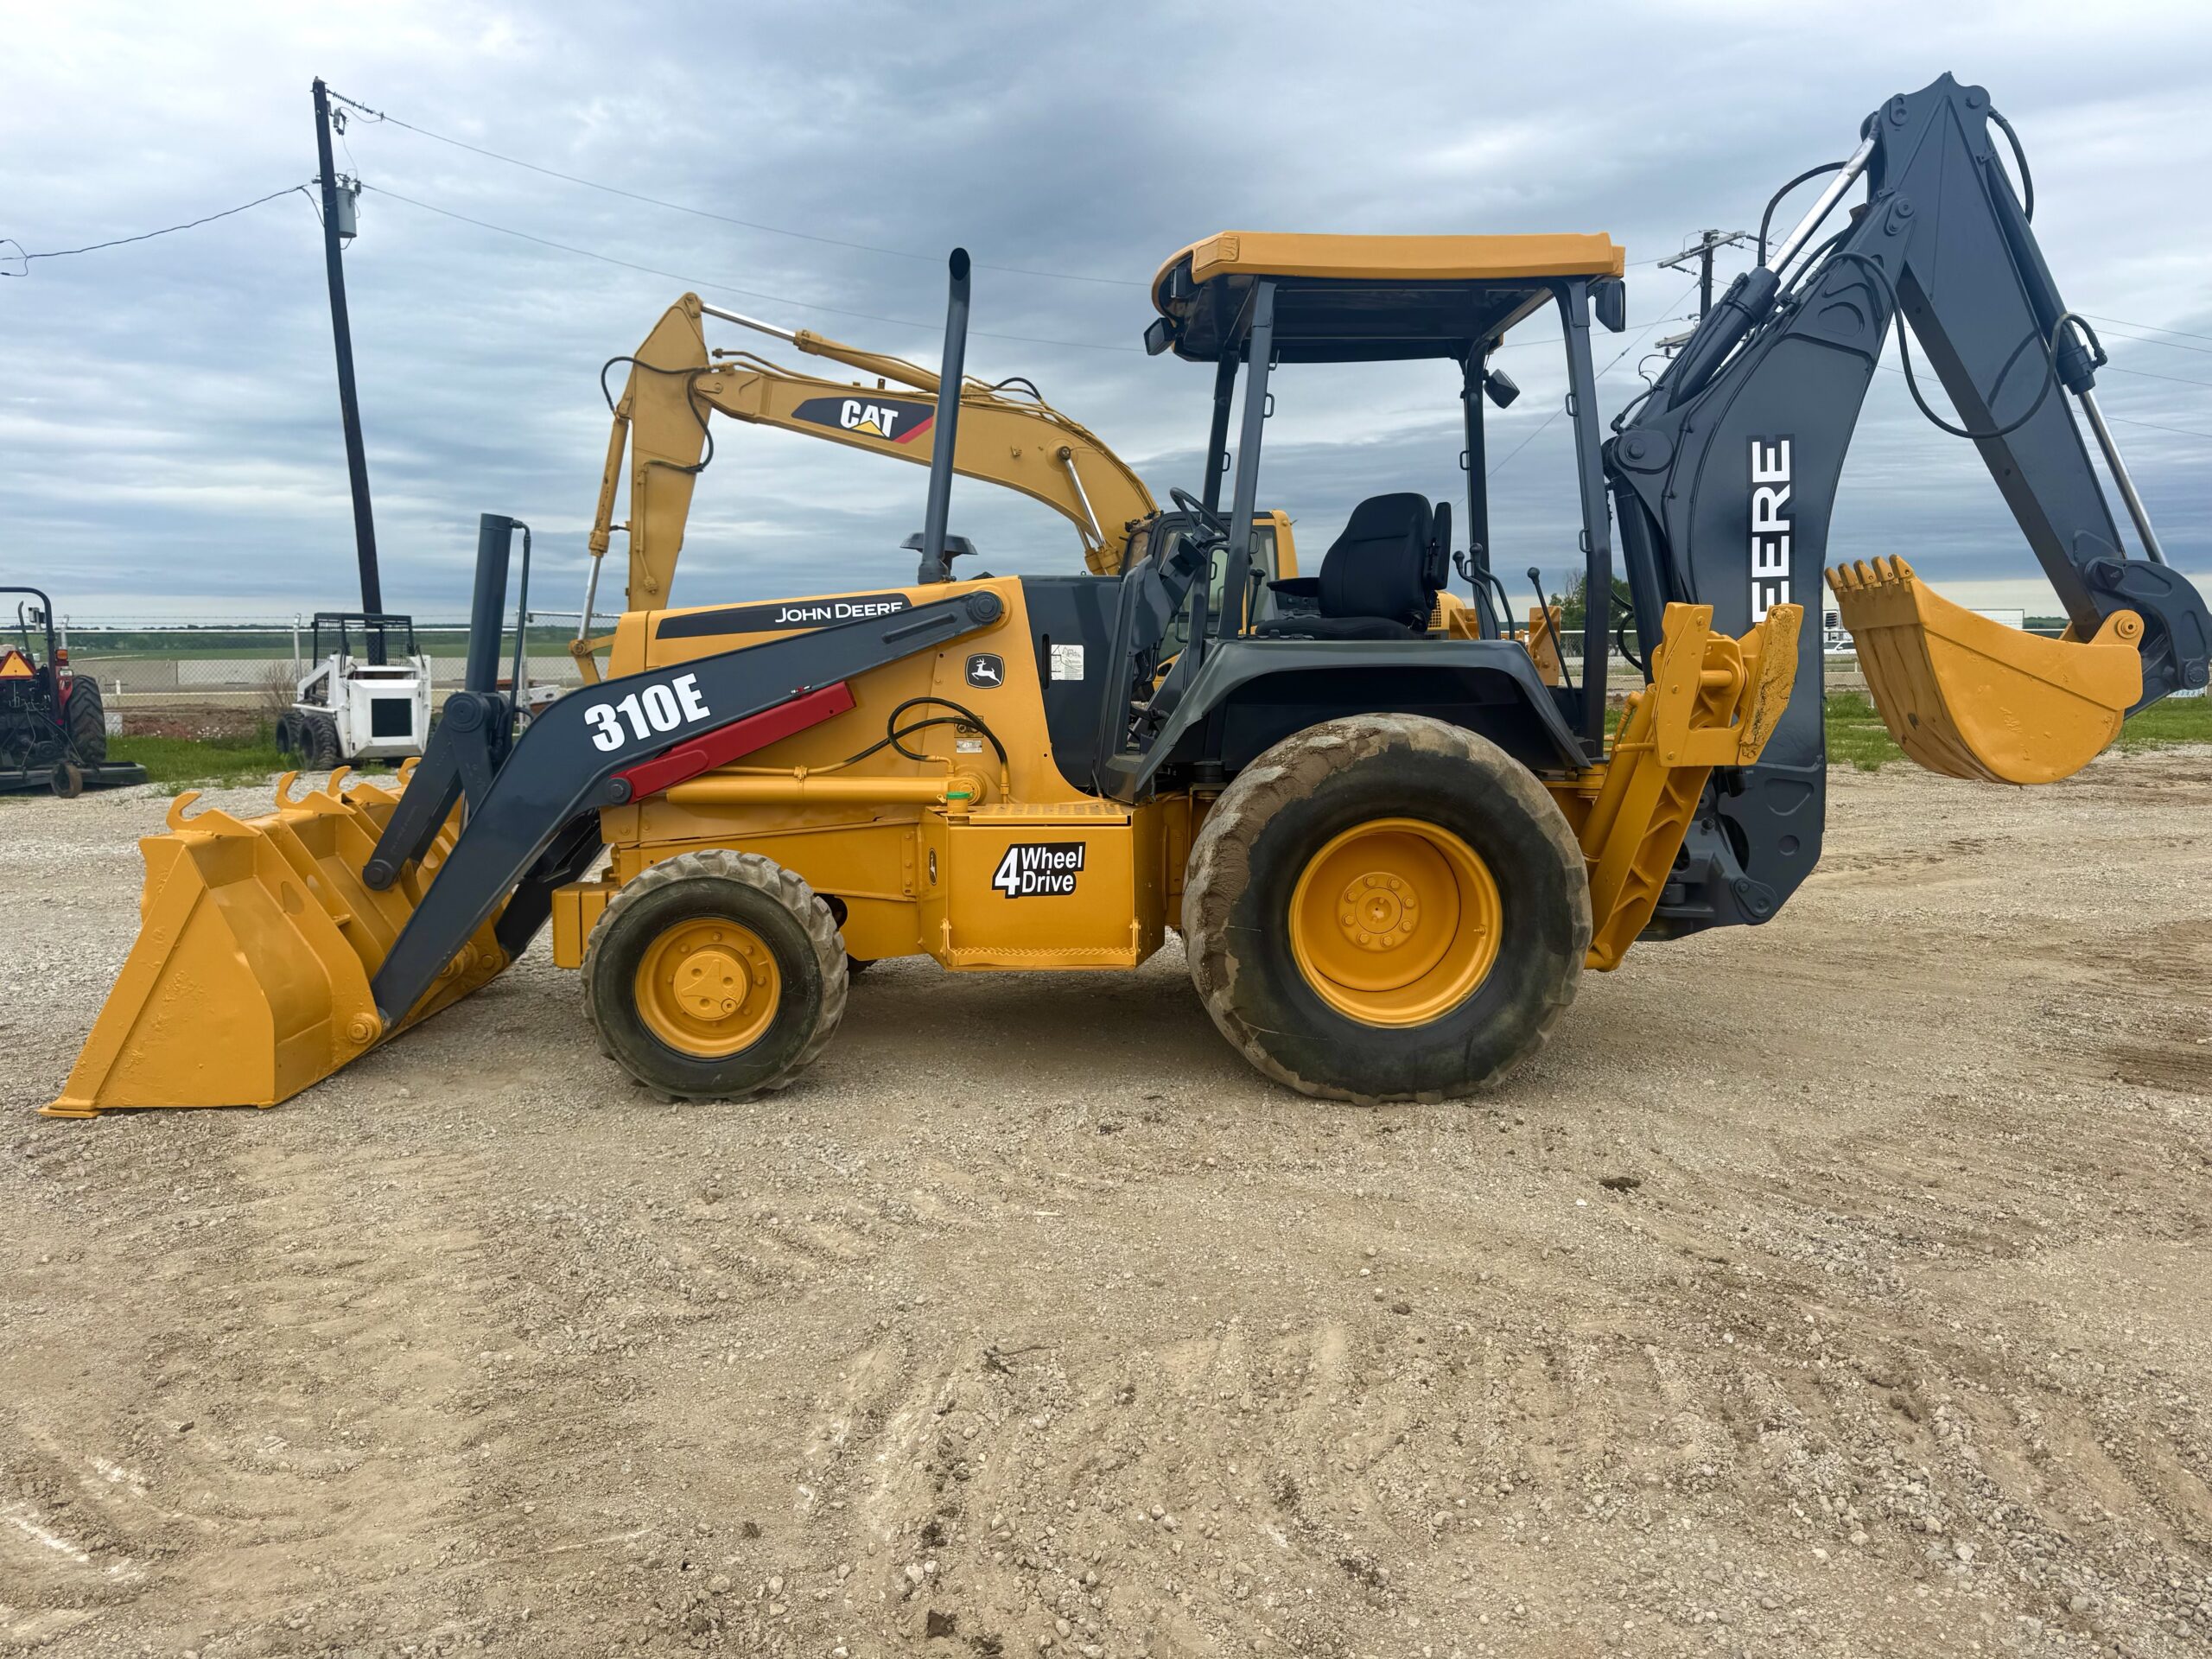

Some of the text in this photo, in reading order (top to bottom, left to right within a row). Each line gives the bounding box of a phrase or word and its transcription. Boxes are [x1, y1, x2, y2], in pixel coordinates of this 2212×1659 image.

[840, 400, 899, 438] CAT
[775, 607, 831, 623] JOHN
[584, 672, 711, 752] 310E
[995, 846, 1084, 895] 4 Wheel
[1021, 870, 1074, 893] Drive
